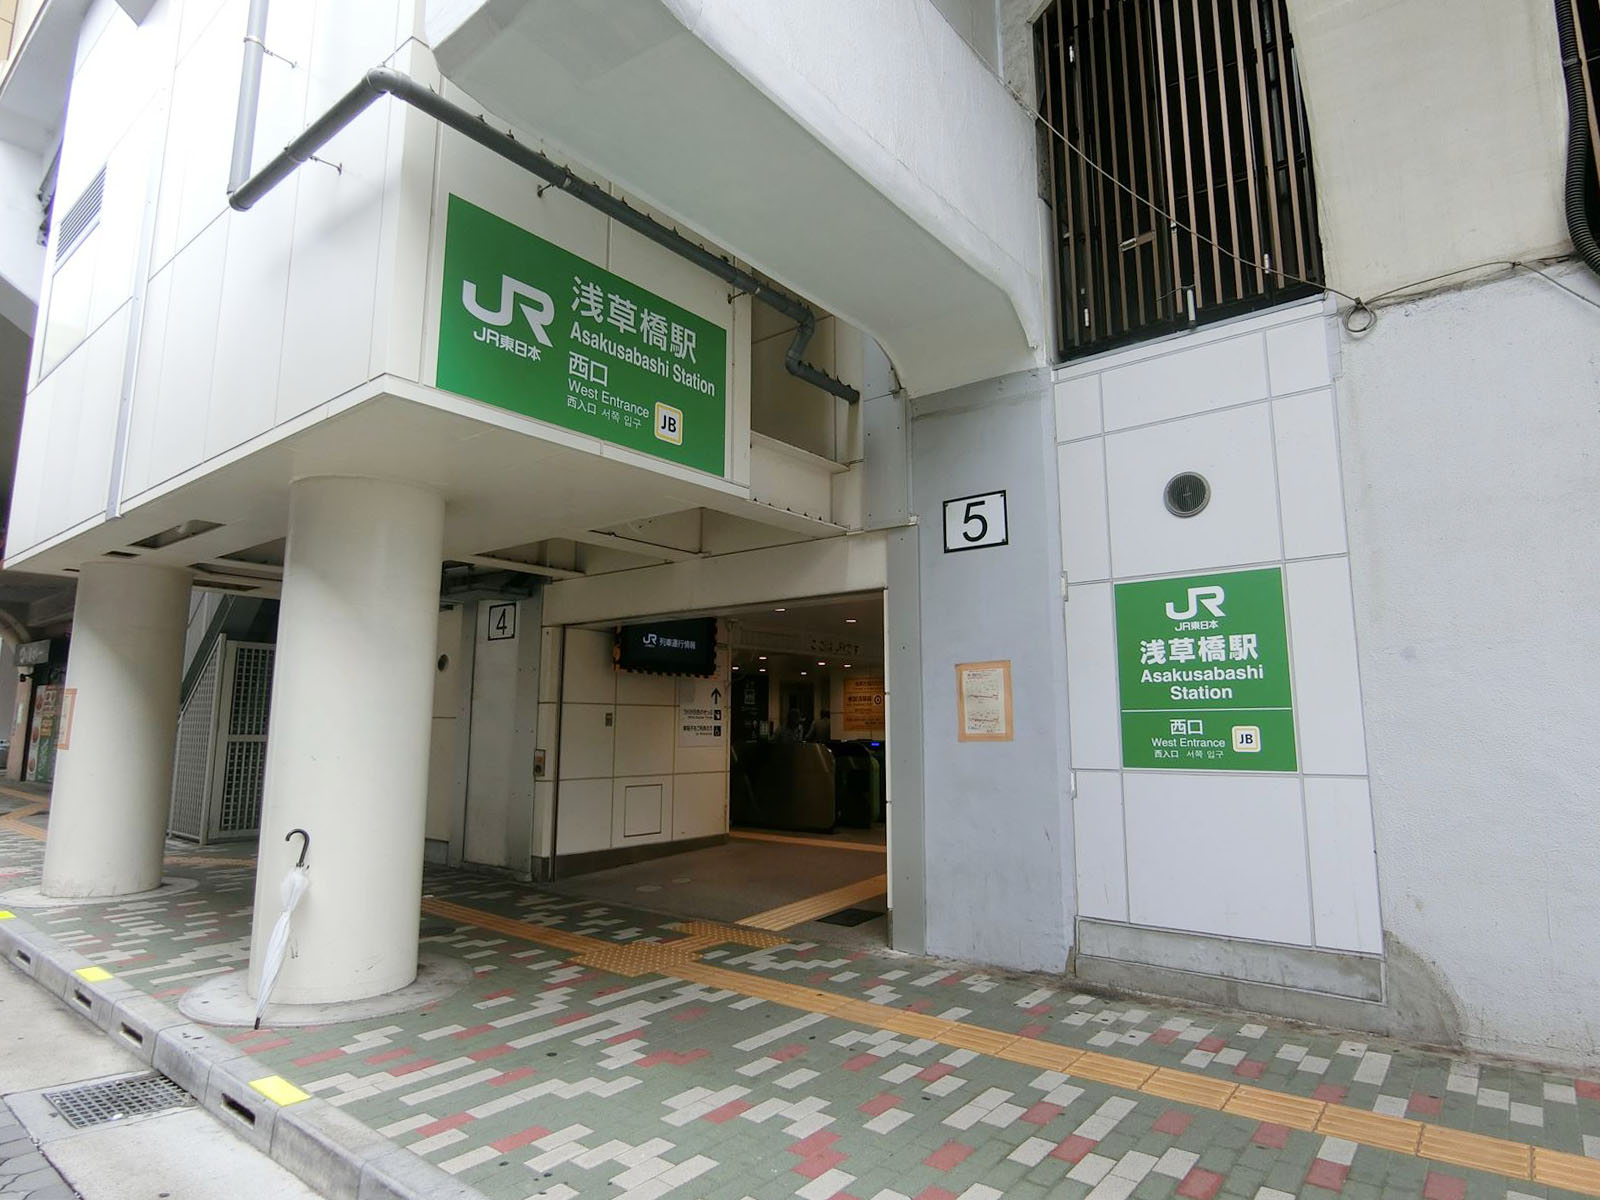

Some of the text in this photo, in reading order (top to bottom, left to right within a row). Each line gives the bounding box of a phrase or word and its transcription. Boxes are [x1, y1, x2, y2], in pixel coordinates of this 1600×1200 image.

[462, 274, 555, 348] JR
[571, 276, 697, 364] 浅草橋駅
[473, 327, 541, 361] JR東日本
[569, 351, 608, 387] 西口
[570, 321, 715, 397] Asakusabashi Station
[567, 395, 597, 415] 西入口
[568, 378, 649, 418] West Entrance
[623, 415, 642, 429] 입구
[661, 415, 677, 433] JB
[962, 500, 988, 542] 5
[1165, 585, 1227, 620] JR
[496, 608, 507, 635] 4
[1174, 620, 1219, 631] JR東日本
[642, 633, 657, 645] JR
[1140, 634, 1258, 665] 浅草橋駅
[1141, 664, 1264, 683] Asakusabashi
[1170, 685, 1233, 700] Station
[1169, 719, 1204, 735] 西口
[1151, 738, 1226, 748] West Entrance
[1239, 734, 1254, 744] JB
[1154, 750, 1179, 758] 西入口
